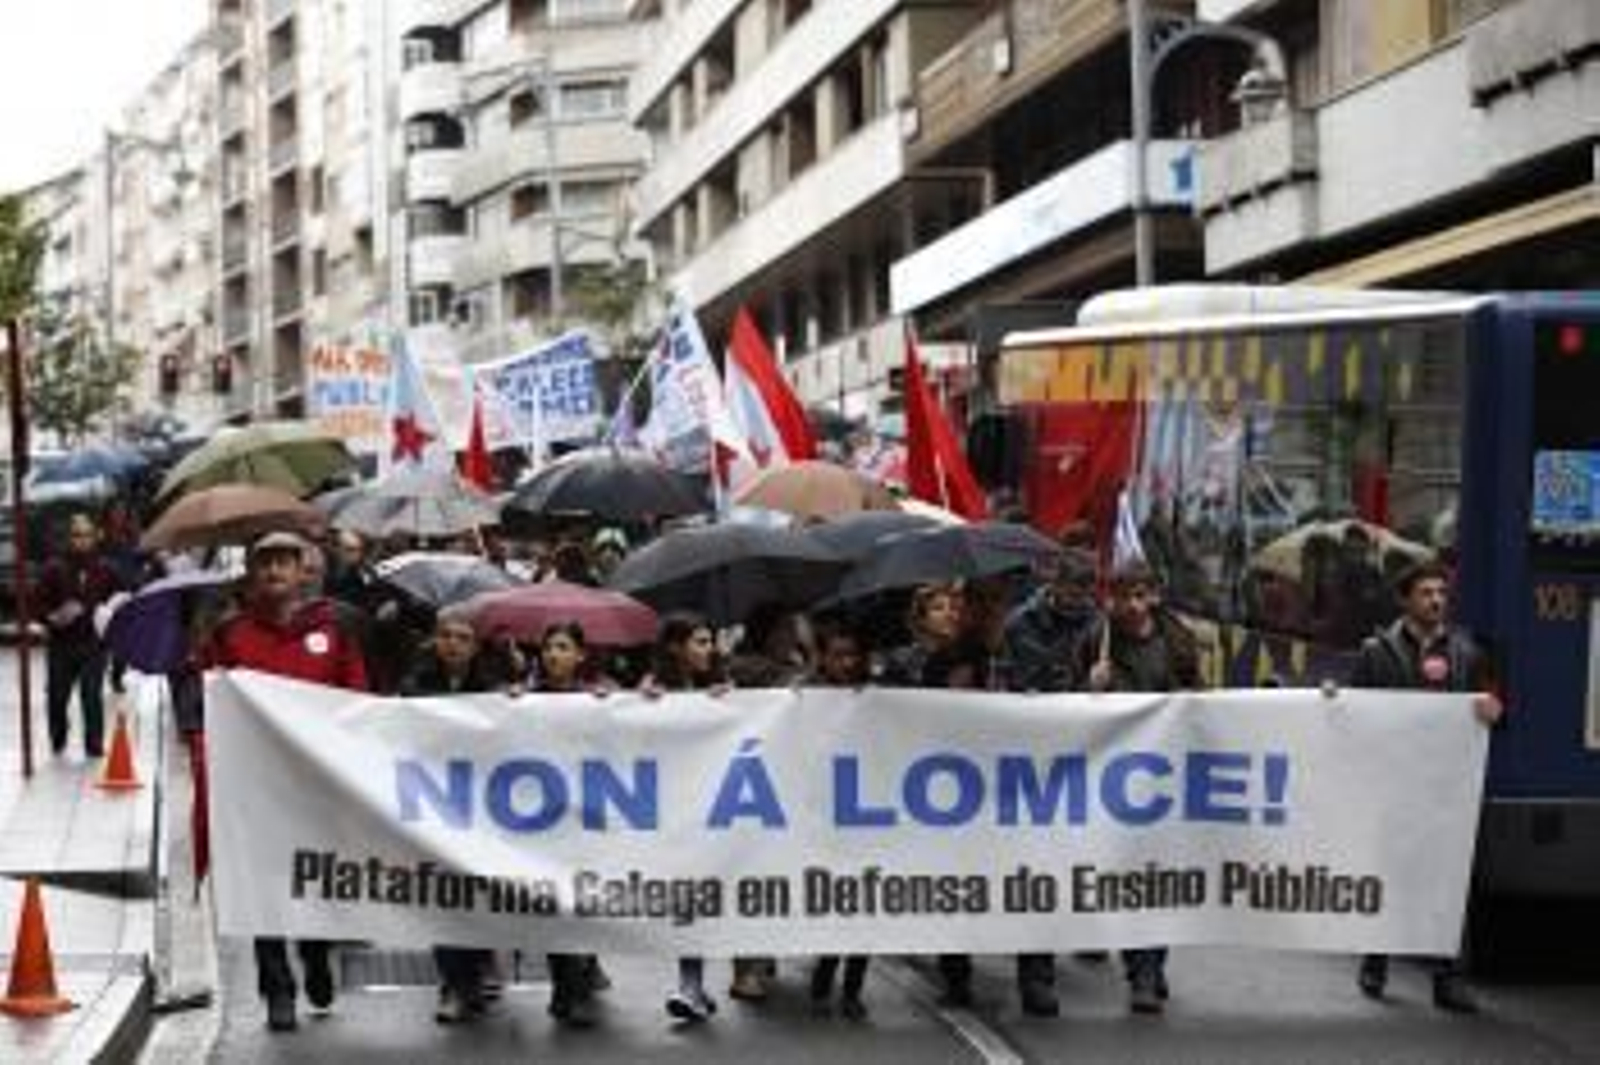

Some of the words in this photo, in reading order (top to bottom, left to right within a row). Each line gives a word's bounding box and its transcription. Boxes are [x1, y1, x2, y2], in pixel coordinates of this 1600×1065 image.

[394, 757, 658, 833] NON
[707, 738, 787, 829] Á
[832, 752, 1289, 827] LOMCE!
[291, 849, 559, 918] Plataforma
[571, 870, 722, 927] Galega
[737, 876, 790, 918] en
[804, 867, 990, 915] Defensa
[1003, 866, 1057, 914] do
[1071, 861, 1206, 915] Ensino
[1219, 861, 1382, 915] Público
